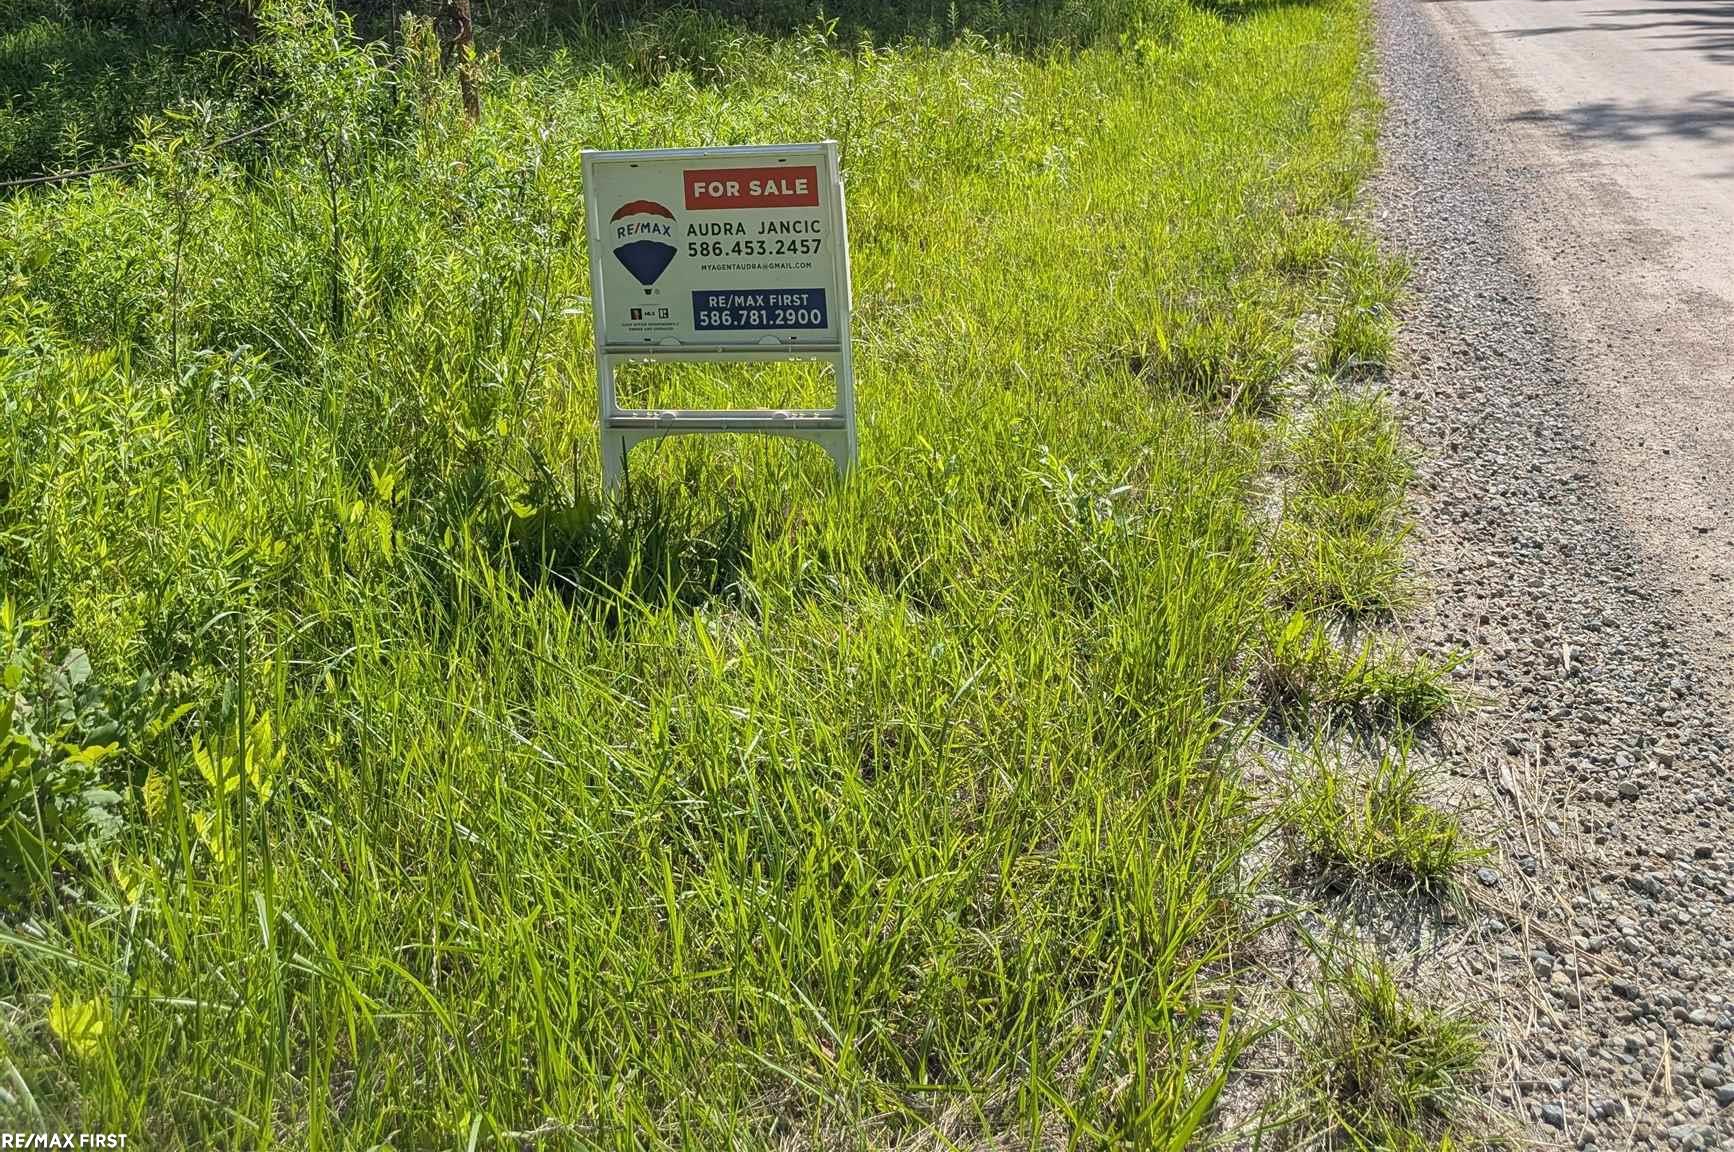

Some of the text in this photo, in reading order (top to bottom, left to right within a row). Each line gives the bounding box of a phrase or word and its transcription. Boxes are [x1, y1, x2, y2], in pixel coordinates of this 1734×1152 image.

[694, 178, 809, 198] FOR SALE
[617, 222, 672, 239] RE/MAX
[687, 220, 821, 237] AUDRA JANCIC
[688, 239, 822, 258] 586.453.2457
[709, 294, 809, 307] RE/MAX FIRST
[699, 309, 821, 326] 586.781.2900
